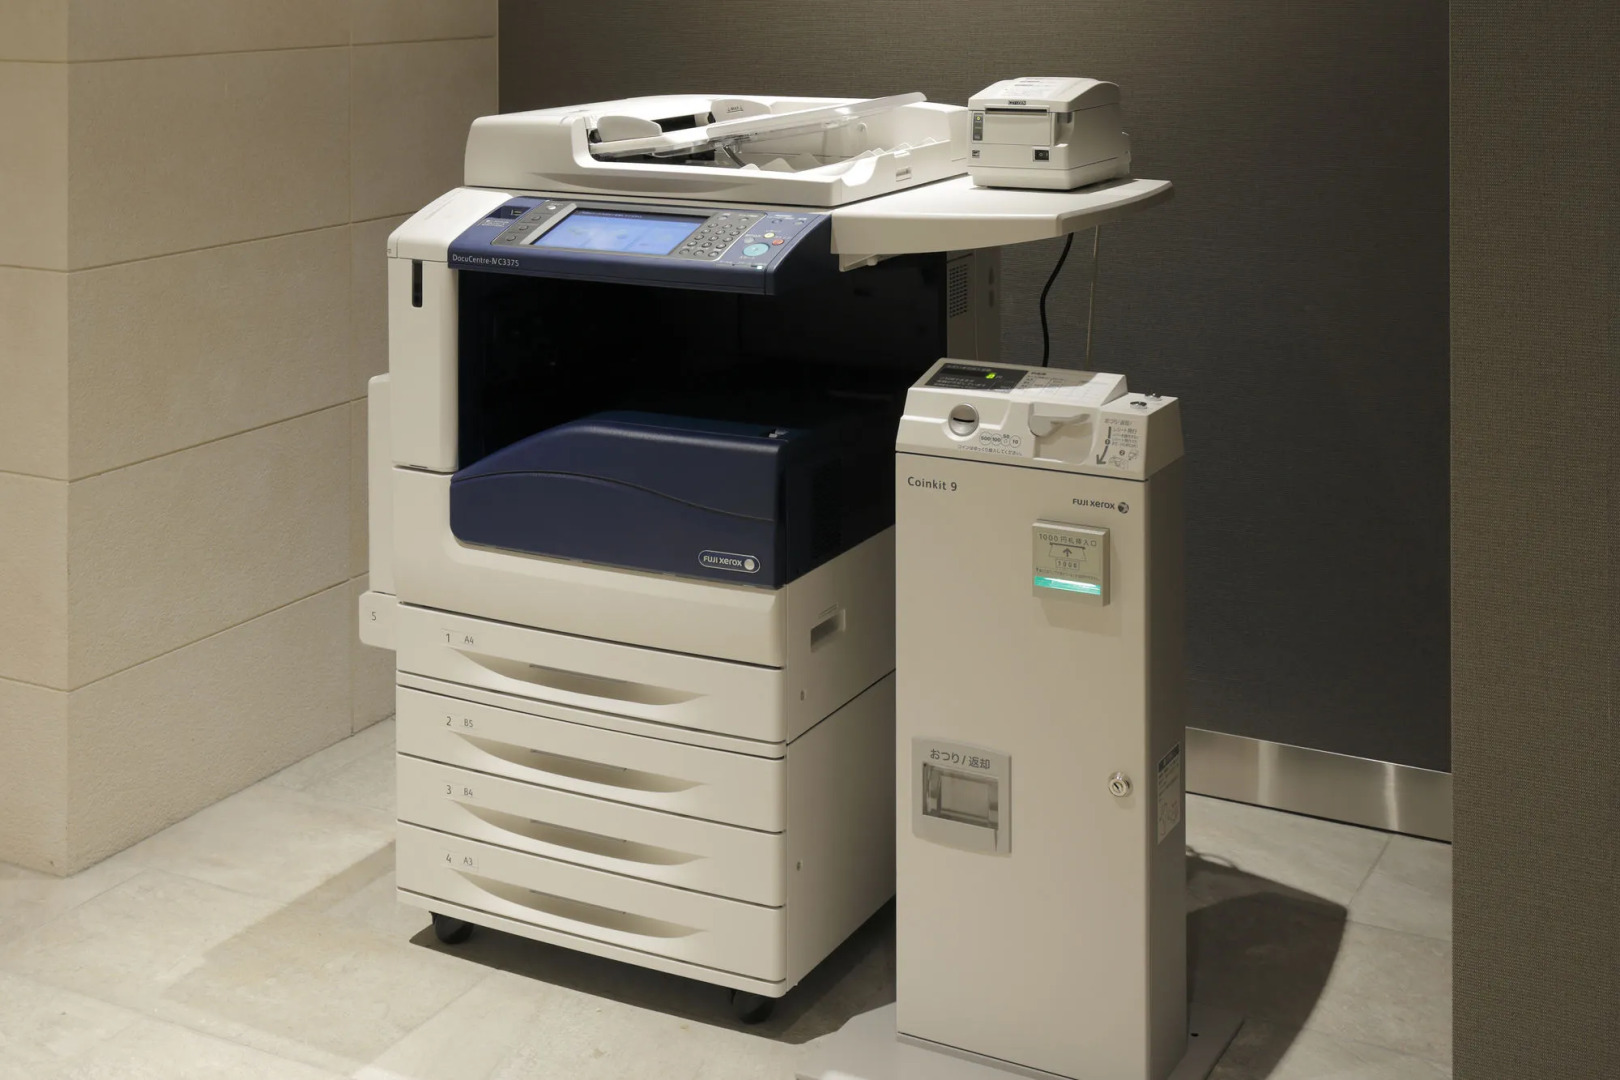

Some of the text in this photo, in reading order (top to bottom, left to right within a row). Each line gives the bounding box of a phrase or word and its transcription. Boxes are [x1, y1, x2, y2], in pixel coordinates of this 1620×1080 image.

[907, 476, 958, 492] Coinkit 9
[1072, 498, 1116, 510] FUJI xerox
[703, 555, 743, 567] FUJI xerox
[371, 611, 377, 621] 5
[445, 633, 474, 645] 1 A4
[446, 715, 474, 728] 2 B5
[446, 784, 474, 797] 3 B4
[445, 853, 473, 866] 4 A3
